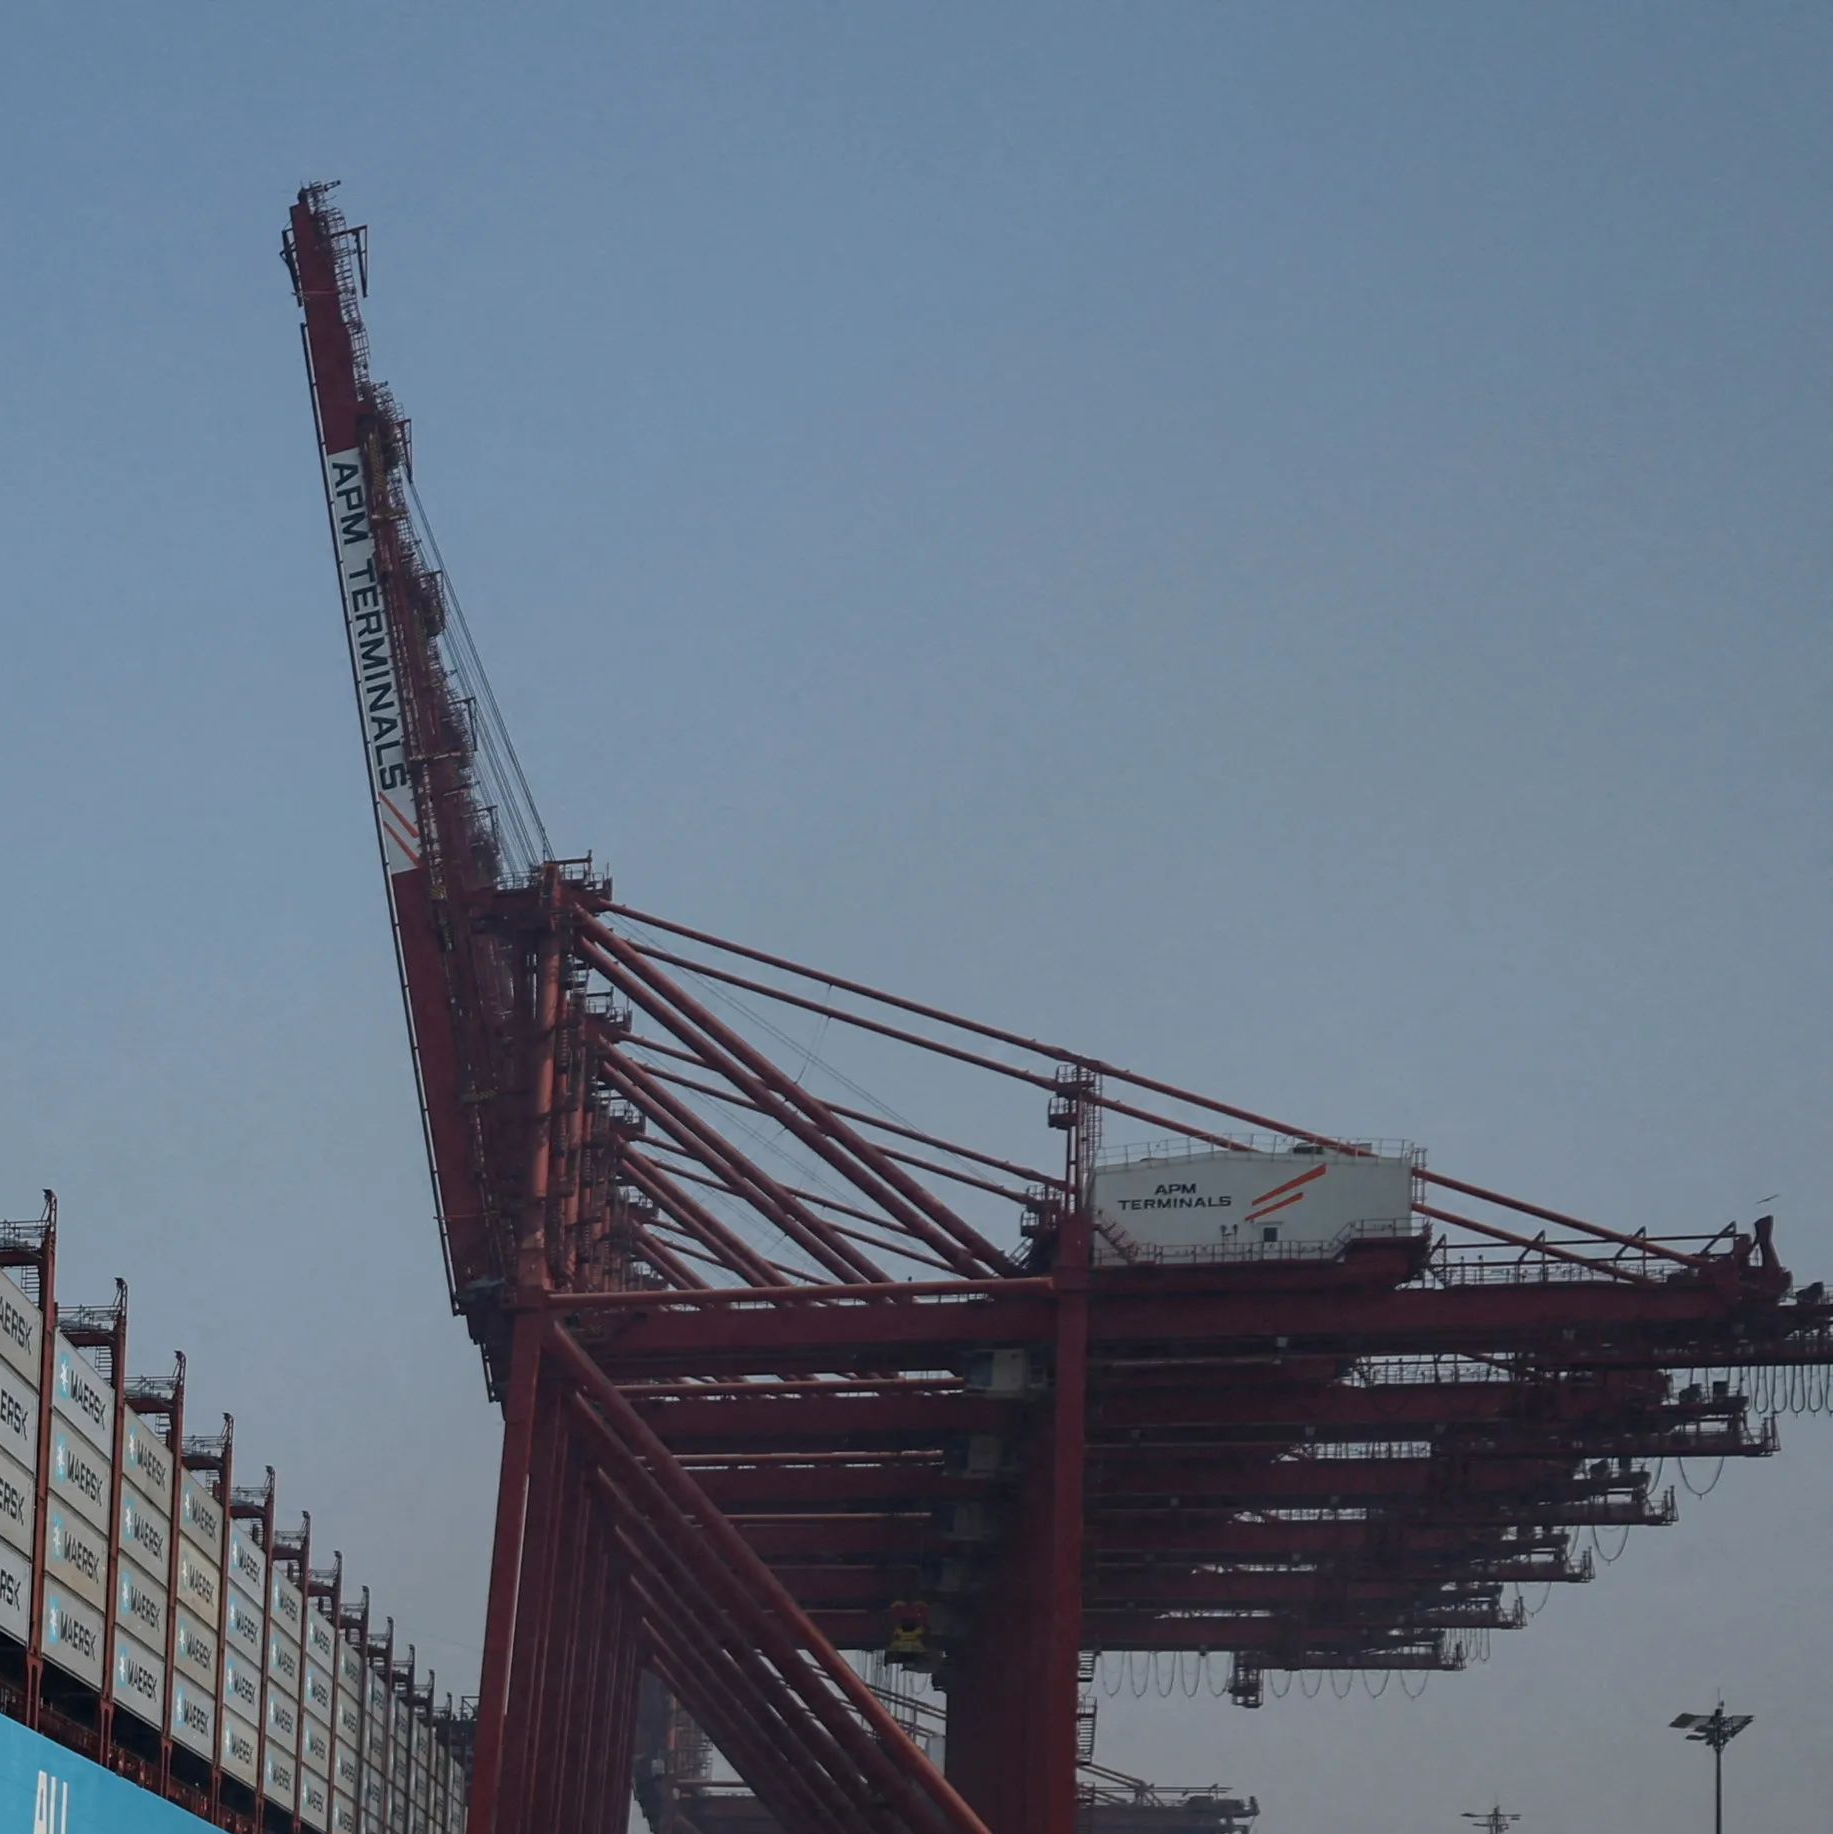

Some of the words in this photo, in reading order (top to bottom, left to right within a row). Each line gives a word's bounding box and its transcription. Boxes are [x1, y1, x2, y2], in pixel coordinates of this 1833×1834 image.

[332, 459, 368, 546] APM
[348, 557, 407, 792] TERMINALS
[1117, 1196, 1232, 1211] TERMINALS
[1154, 1183, 1197, 1196] APM
[70, 1368, 106, 1431] MAERSK
[67, 1449, 103, 1507] MAERSK
[136, 1438, 167, 1492] MAERSK
[134, 1511, 164, 1563] MAERSK
[191, 1495, 218, 1543] MAERSK
[63, 1529, 100, 1585] MAERSK
[130, 1584, 160, 1633] MAERSK
[188, 1564, 215, 1609] MAERSK
[60, 1610, 96, 1662] MAERSK
[186, 1632, 213, 1672] MAERSK
[127, 1657, 158, 1703] MAERSK
[183, 1699, 210, 1738] MAERSK
